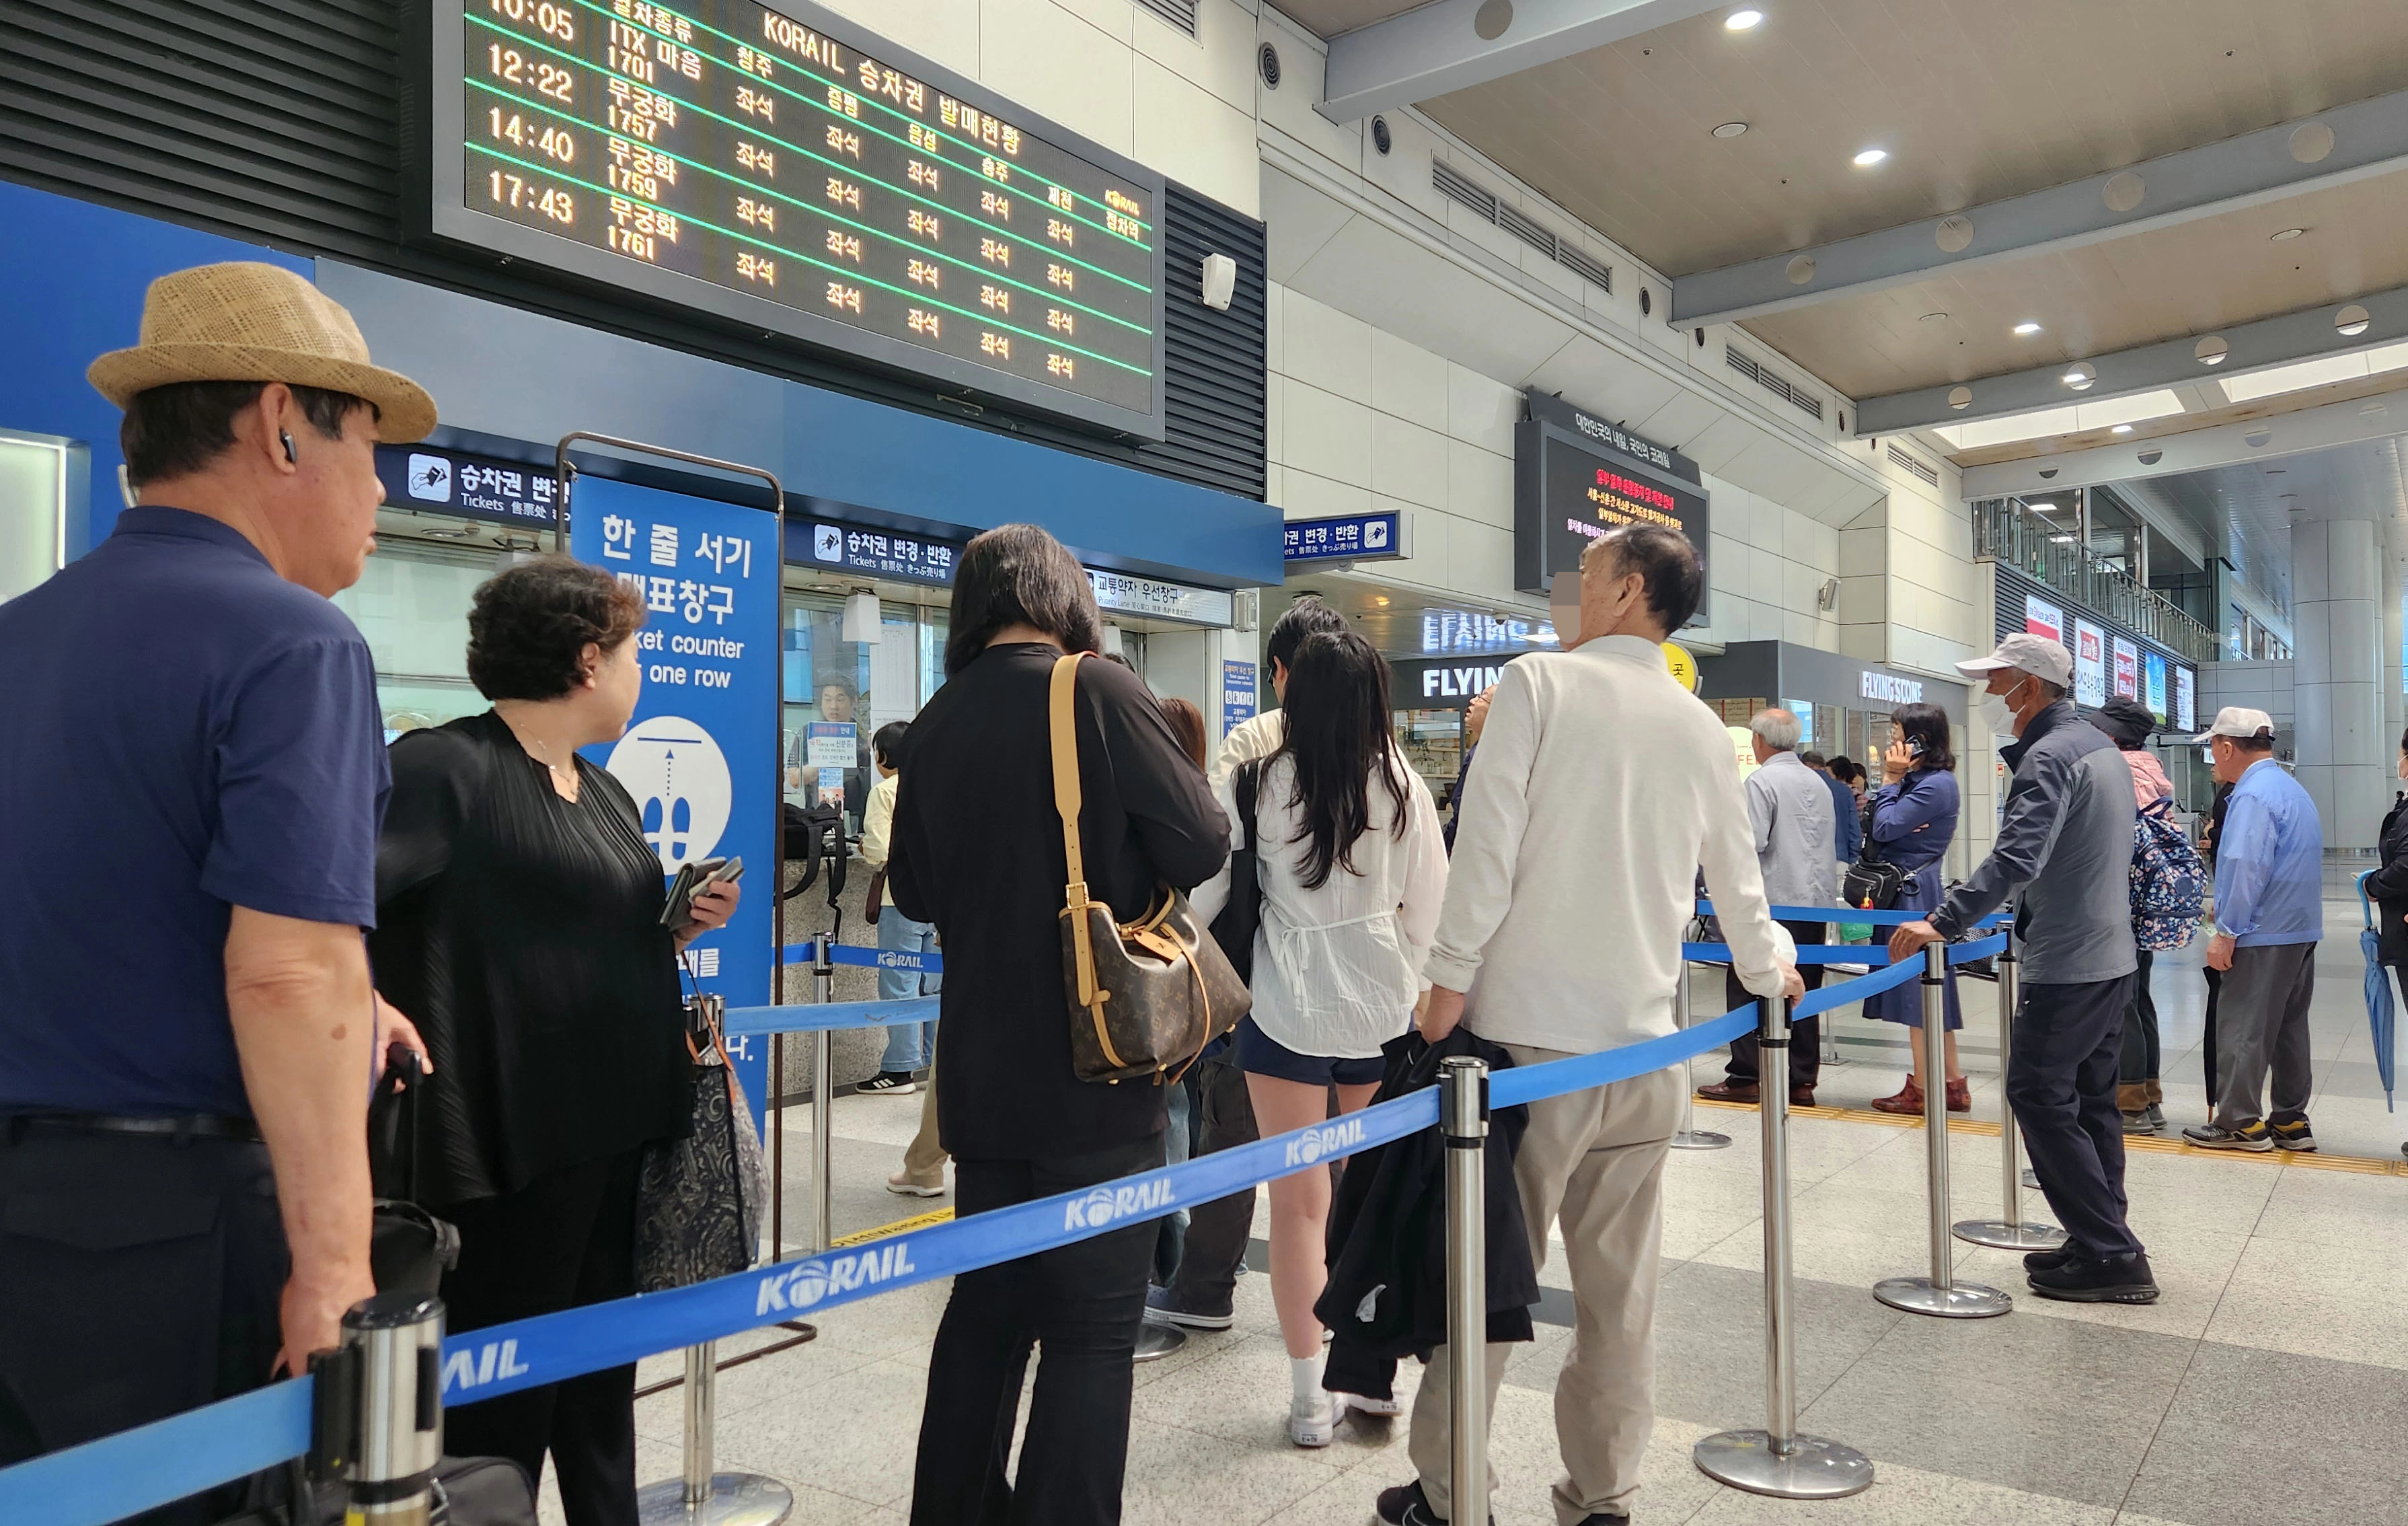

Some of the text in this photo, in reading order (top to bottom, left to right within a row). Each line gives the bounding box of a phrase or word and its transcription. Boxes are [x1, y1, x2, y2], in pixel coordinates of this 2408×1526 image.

[607, 46, 653, 83] 1701
[609, 20, 647, 55] ITX
[657, 42, 702, 79] 마음
[489, 44, 677, 128] 12:22 무궁화
[764, 12, 1020, 156] KORAIL 승차권 발매현황
[608, 106, 658, 141] 1757
[489, 106, 677, 185] 14:40 무궁화
[737, 86, 1073, 248] 좌석 좌석 좌석 좌석 좌석
[608, 164, 658, 201] 1759
[489, 170, 679, 243] 17:43 무궁화
[737, 142, 1073, 292] 좌석 좌석 좌석 좌석 좌석
[608, 225, 655, 260] 1761
[737, 197, 1074, 336] 좌석 좌석 좌석 좌석 좌석
[737, 252, 1074, 379] 좌석 좌석 좌석 좌석 좌석
[1575, 412, 1612, 444] 대한민국의
[1629, 437, 1650, 461] 국민의
[1651, 445, 1671, 469] 코레일
[460, 464, 522, 499] 승차권
[461, 492, 504, 511] Tickets
[603, 514, 751, 579] 한 줄 서기
[848, 531, 887, 557] 승차권
[848, 554, 877, 569] Tickets
[1098, 575, 1178, 604] 교통약자 우선창구
[1098, 595, 1117, 608] Priority
[671, 634, 745, 659] counter
[649, 664, 732, 688] one row
[1862, 671, 1923, 704] FLYING SCONE
[877, 951, 924, 969] KORAIL
[1285, 1118, 1366, 1168] KORAIL
[1064, 1178, 1176, 1231] KORAIL
[756, 1242, 915, 1317] KORAIL
